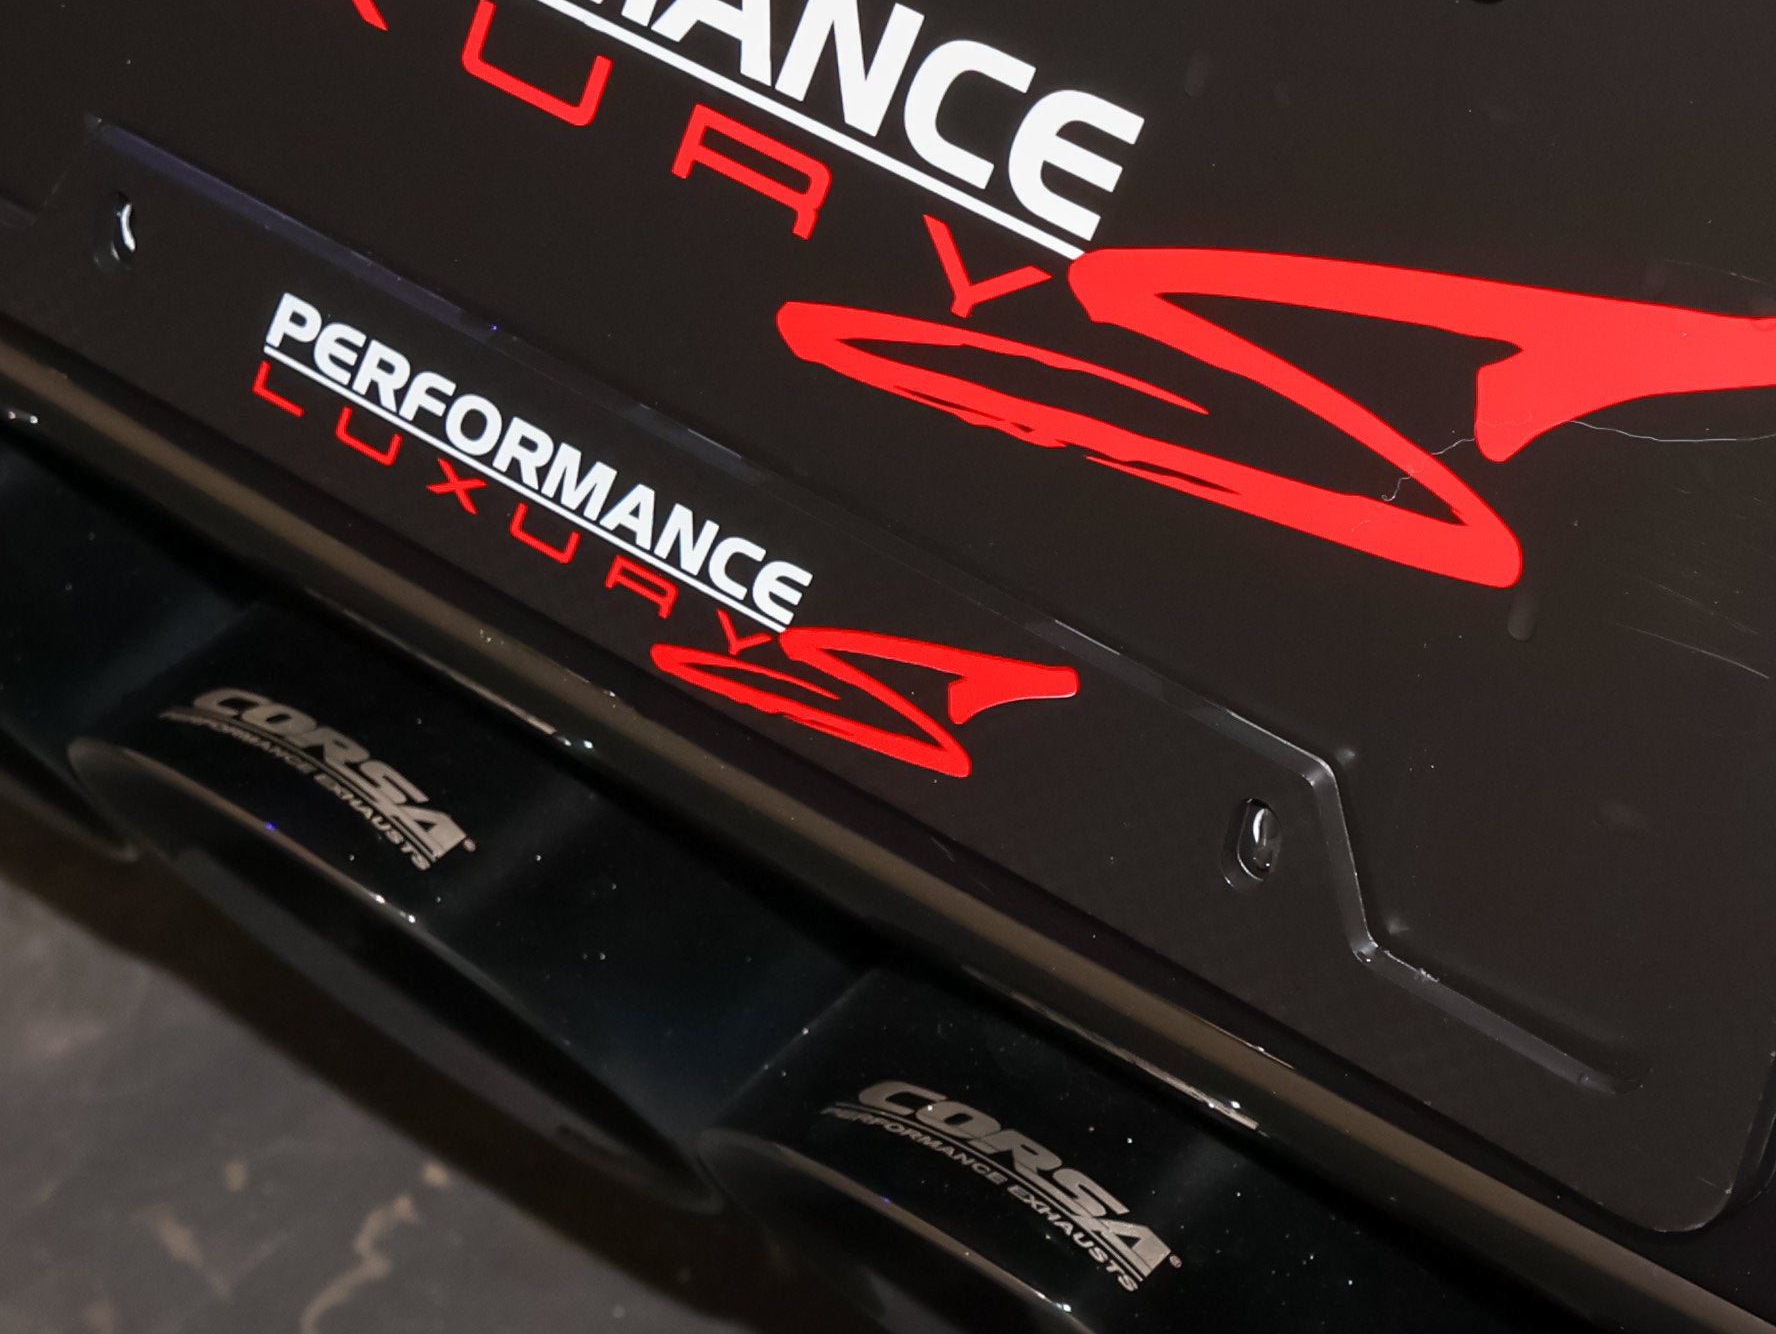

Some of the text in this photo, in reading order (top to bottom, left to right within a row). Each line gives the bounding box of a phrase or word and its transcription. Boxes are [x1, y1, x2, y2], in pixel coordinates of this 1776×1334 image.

[251, 360, 773, 657] LUXURY
[265, 292, 813, 625] PERFORMANCE
[193, 687, 467, 860] CORSA
[858, 1080, 1172, 1278] CORSA
[1006, 1184, 1138, 1293] EXHAUSTS
